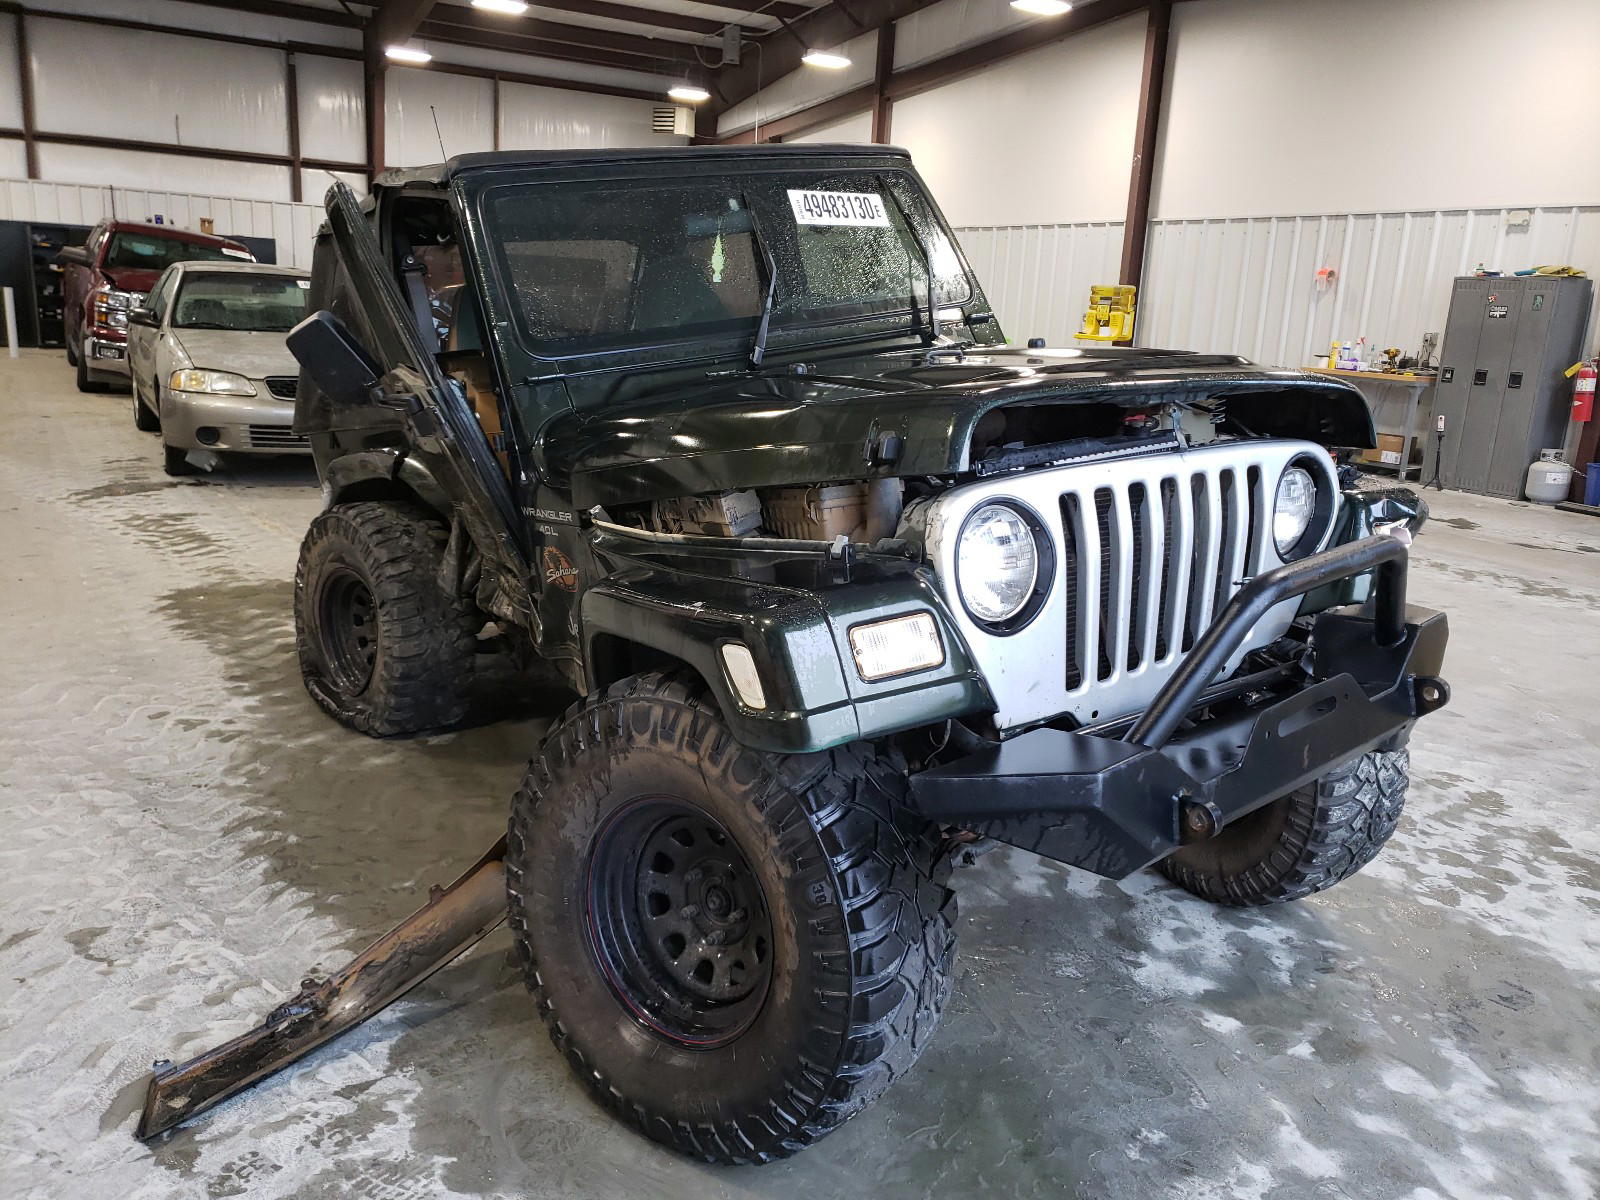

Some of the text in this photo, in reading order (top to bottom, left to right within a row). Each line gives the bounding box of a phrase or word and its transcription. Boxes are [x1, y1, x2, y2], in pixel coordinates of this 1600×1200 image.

[803, 193, 875, 220] 49483130
[521, 506, 573, 522] WRANGLER
[546, 565, 579, 583] Sahara
